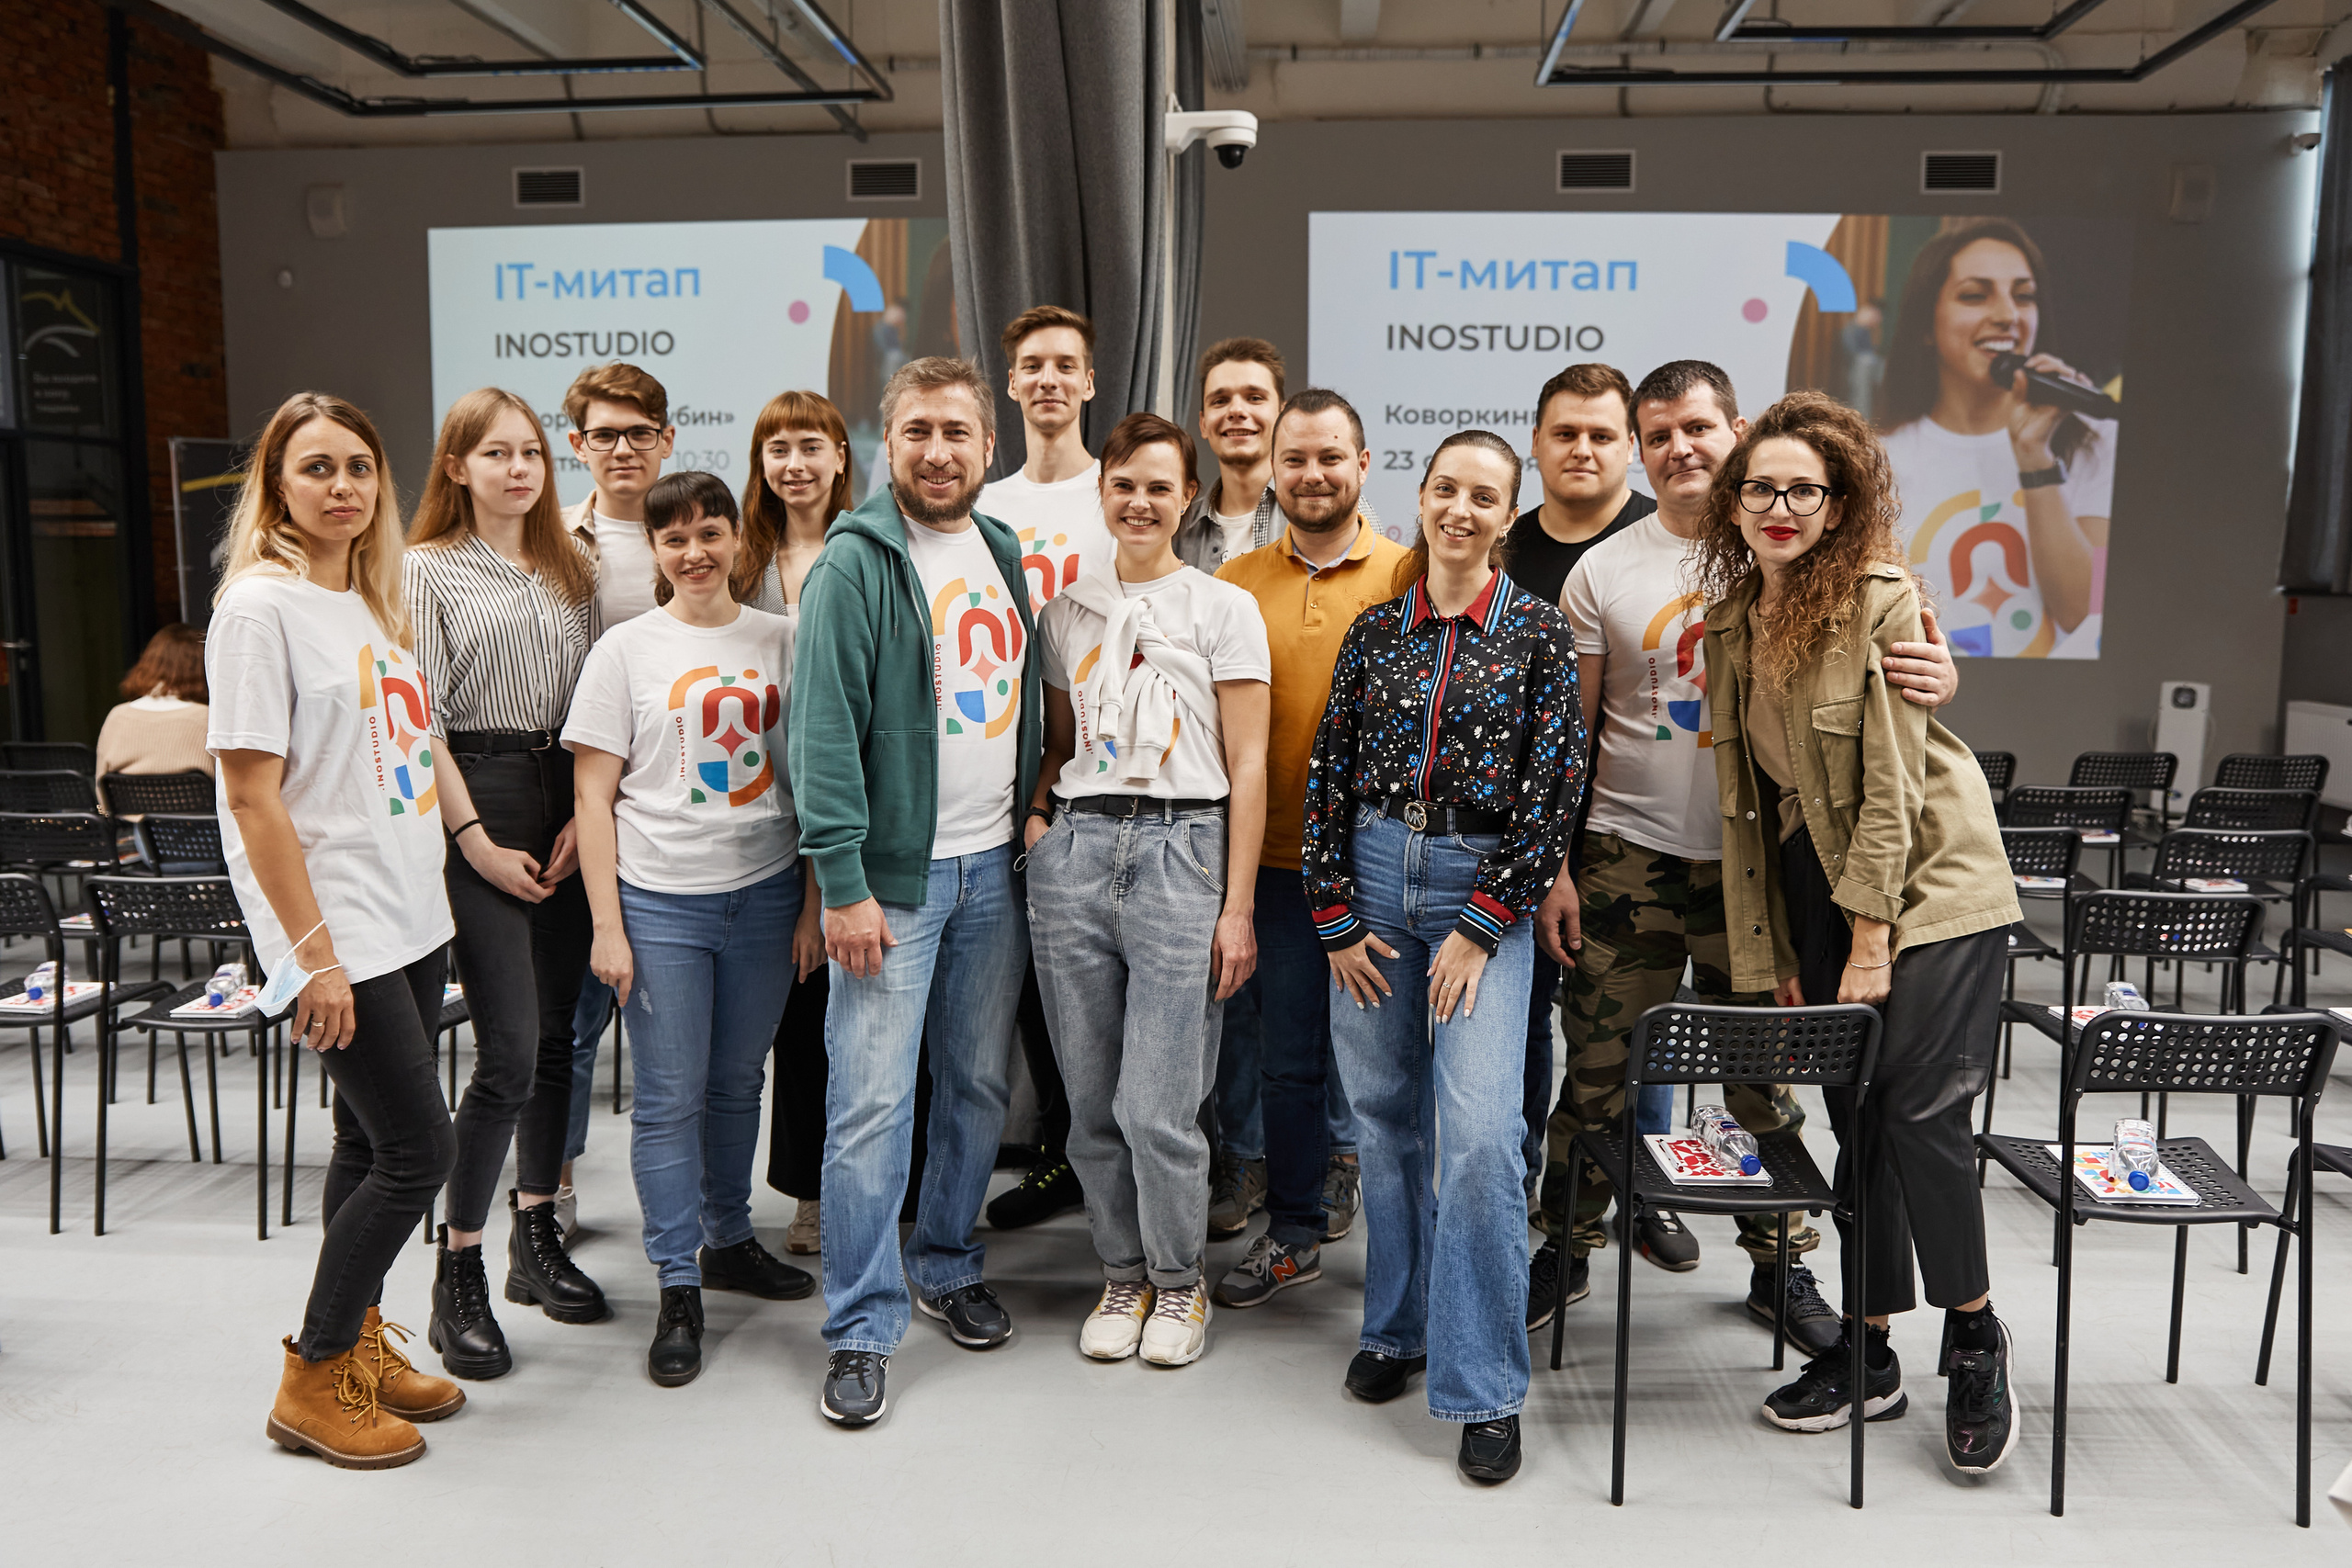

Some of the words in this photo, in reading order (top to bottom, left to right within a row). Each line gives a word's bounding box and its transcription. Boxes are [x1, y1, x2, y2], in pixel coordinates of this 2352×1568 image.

[495, 263, 701, 299] IT-митап
[1389, 251, 1637, 291] IT-митап
[495, 331, 674, 357] INOSTUDIO
[1386, 324, 1604, 352] INOSTUDIO
[674, 450, 730, 470] 10:30
[1383, 450, 1414, 470] 23
